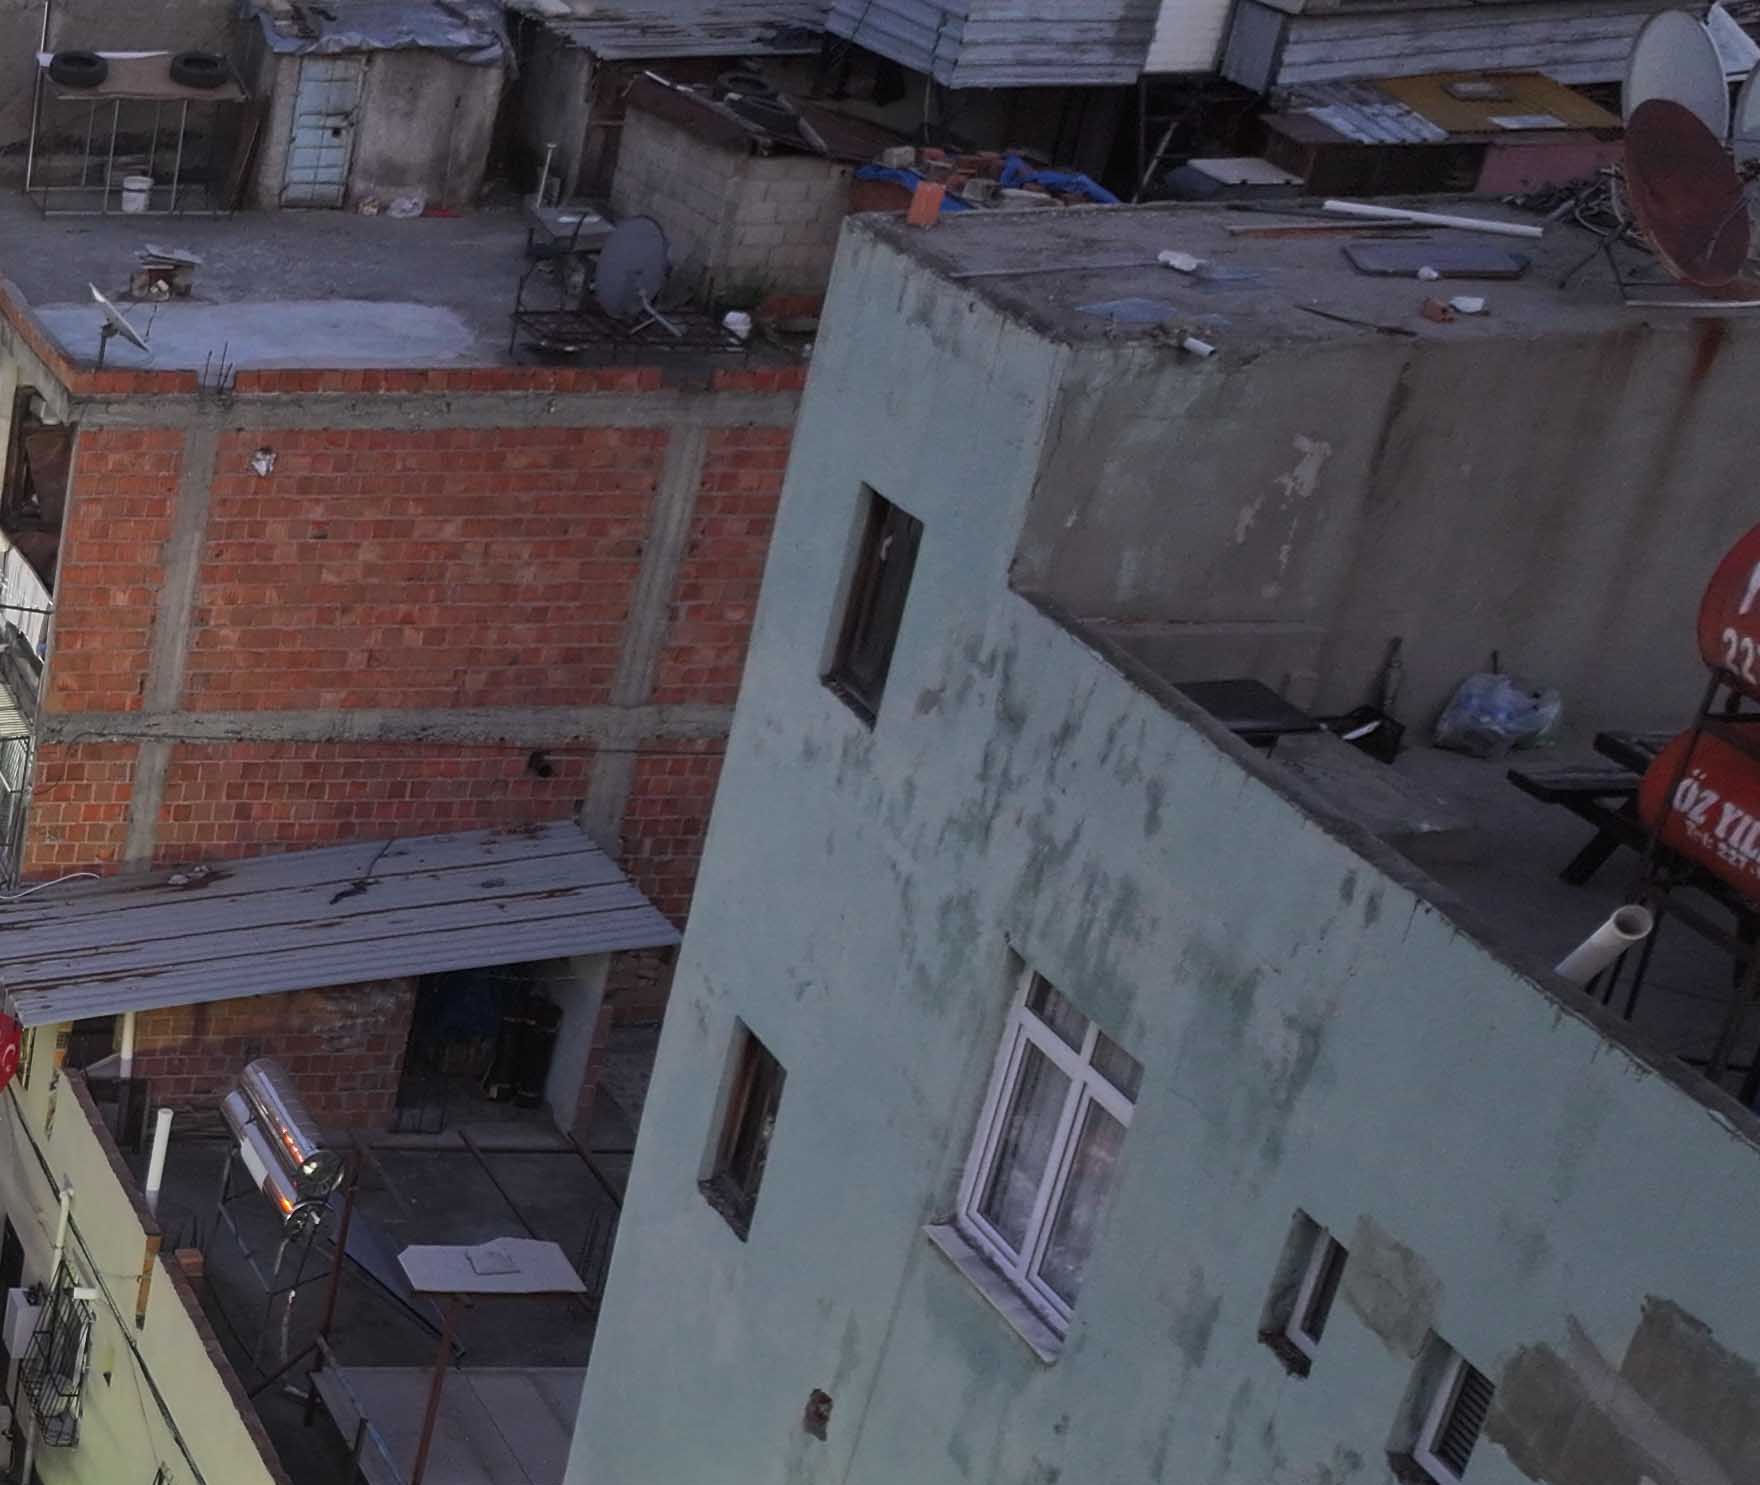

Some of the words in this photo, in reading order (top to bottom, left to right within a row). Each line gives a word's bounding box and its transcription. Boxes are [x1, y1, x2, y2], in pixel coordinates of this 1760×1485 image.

[1722, 627, 1760, 685] 22
[1673, 768, 1721, 824] ÖZ
[1714, 802, 1760, 864] YIL
